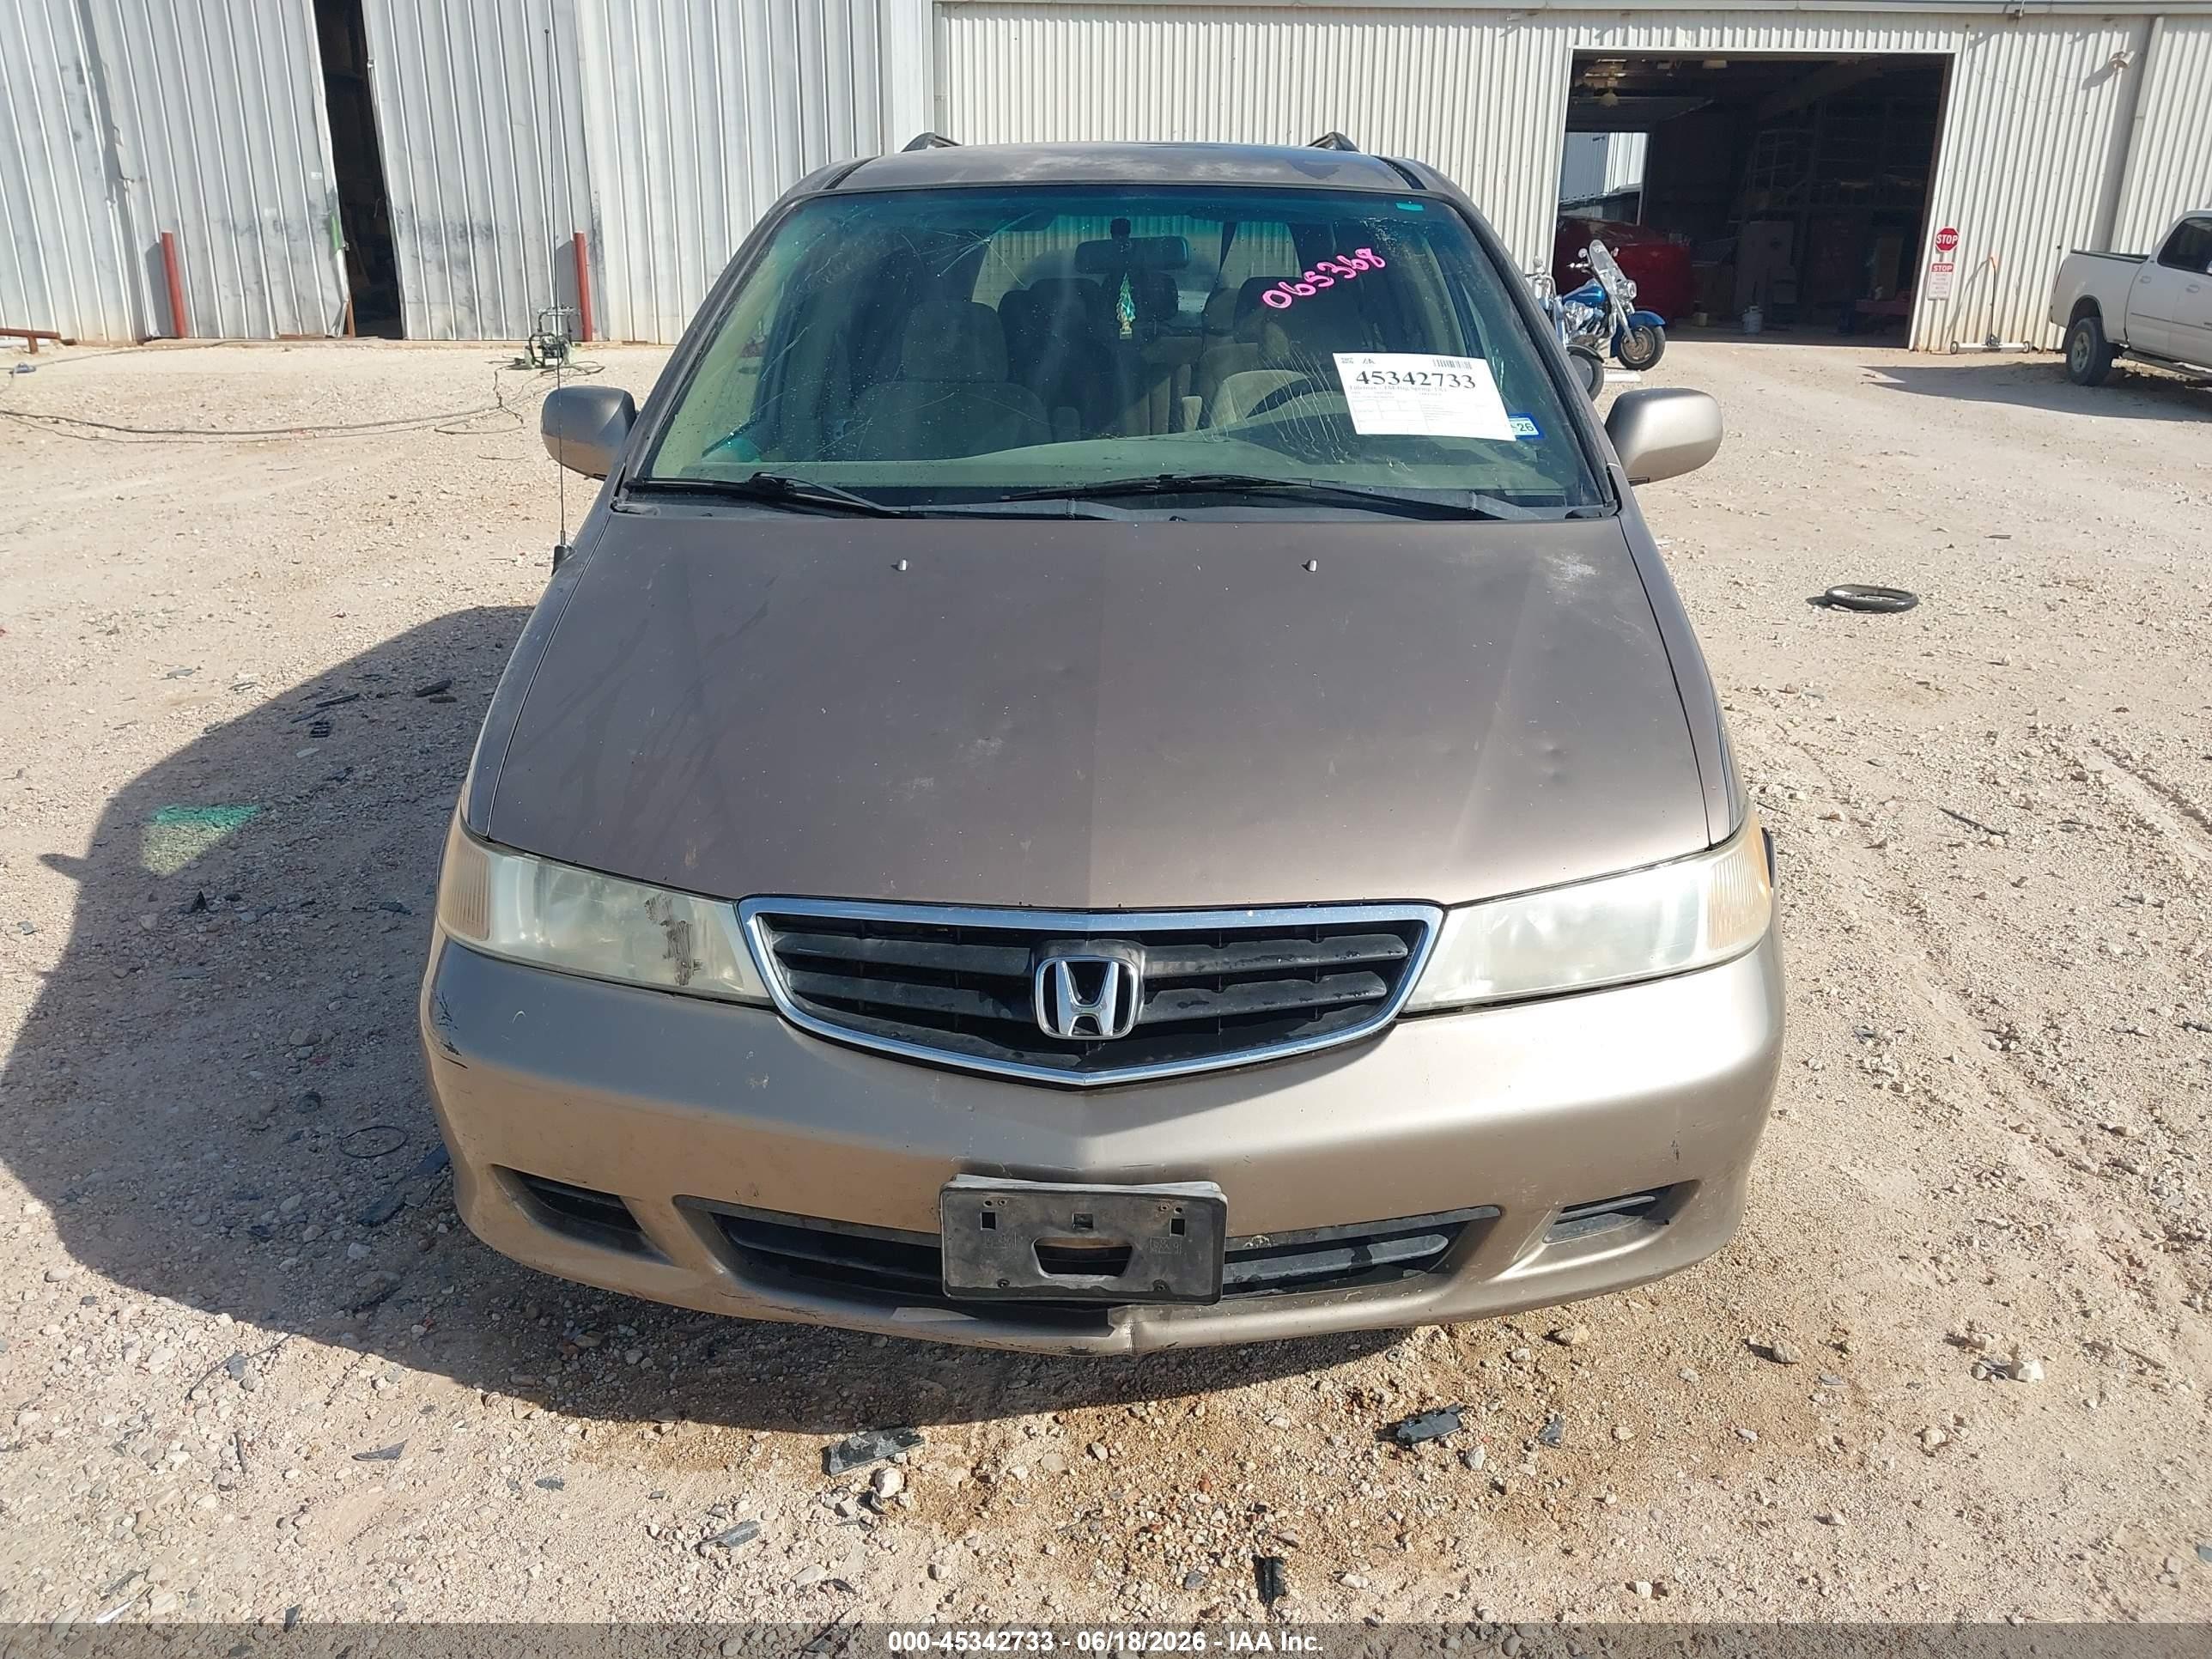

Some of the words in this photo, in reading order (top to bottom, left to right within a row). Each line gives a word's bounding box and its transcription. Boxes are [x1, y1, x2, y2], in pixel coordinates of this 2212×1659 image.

[1936, 234, 1958, 245] STOP
[1262, 247, 1386, 309] 065368
[1356, 371, 1475, 389] 45342733
